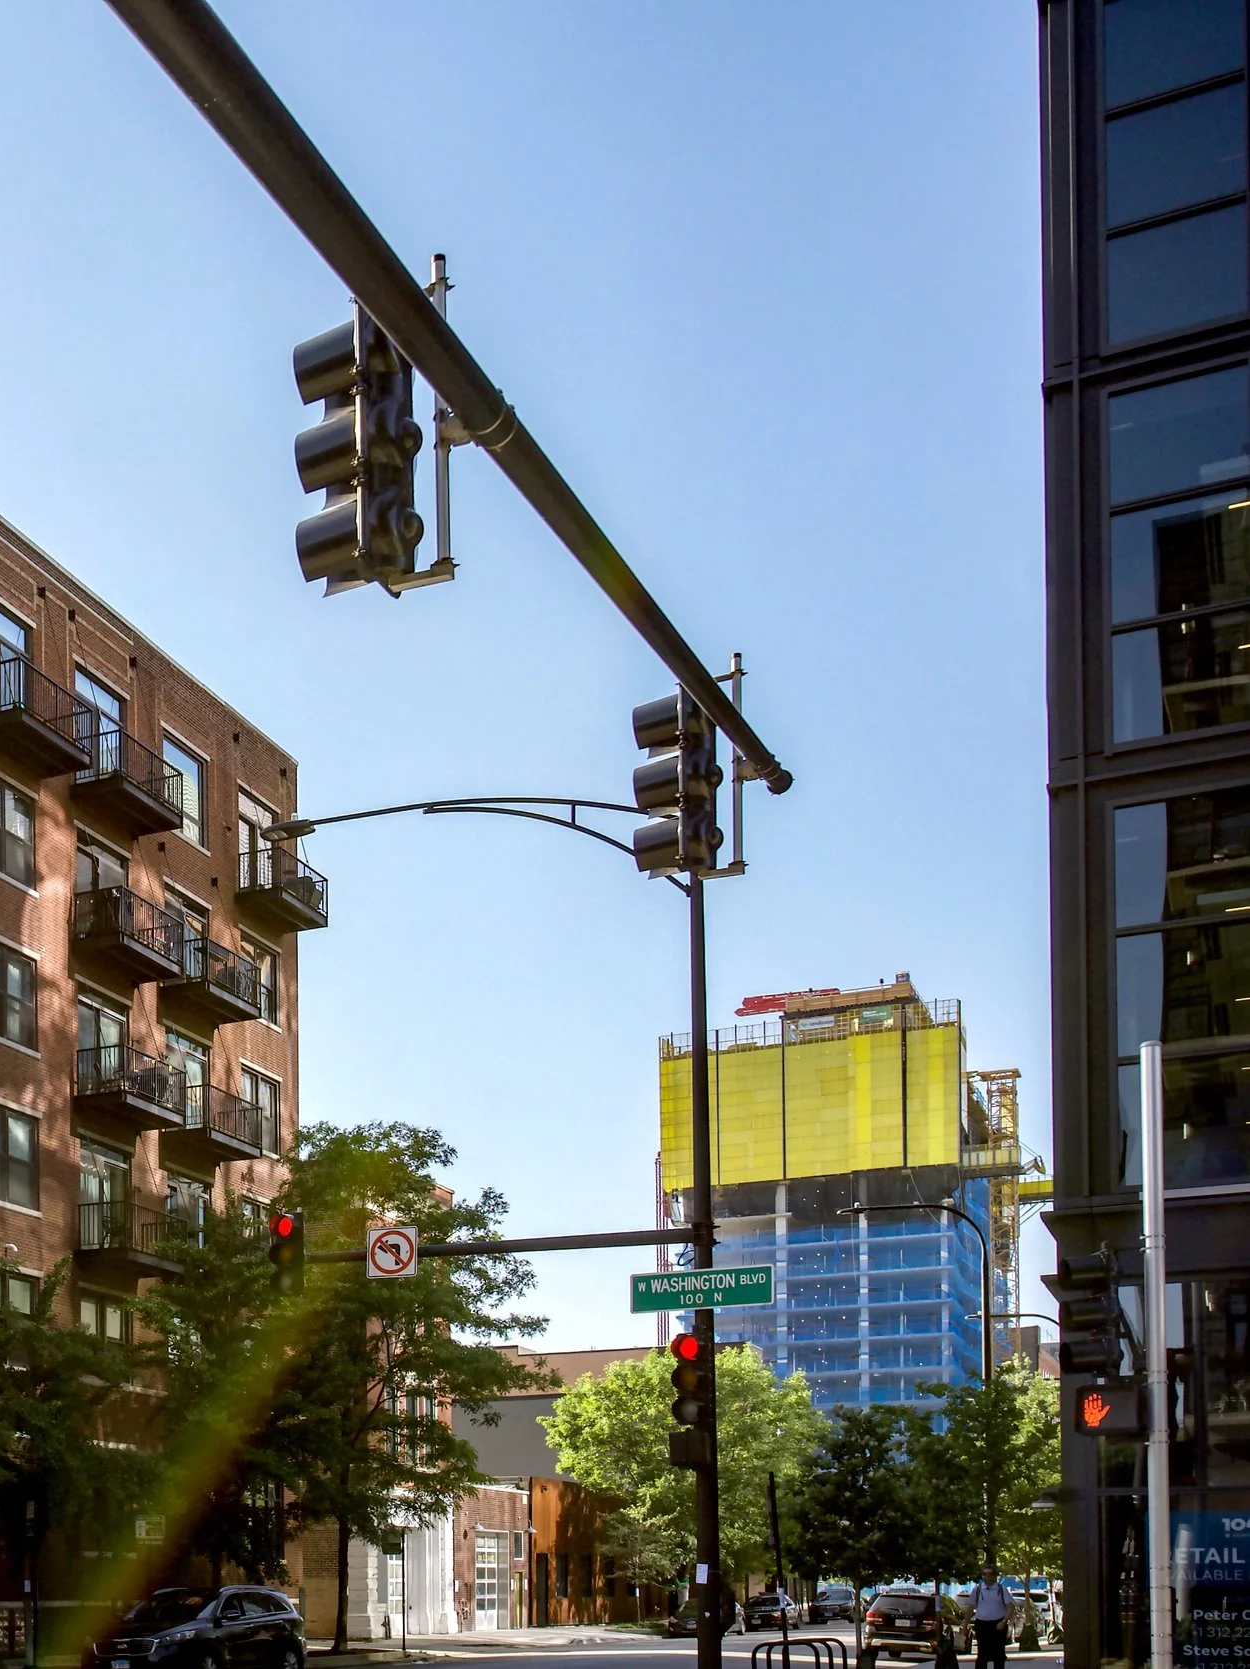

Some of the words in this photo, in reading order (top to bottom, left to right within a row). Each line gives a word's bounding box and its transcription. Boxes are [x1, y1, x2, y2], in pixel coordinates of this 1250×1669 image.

[638, 1282, 646, 1292] W
[651, 1273, 735, 1294] WASHINGTON
[739, 1273, 766, 1285] BLVD
[680, 1294, 703, 1305] 100
[714, 1292, 722, 1303] N
[1169, 1547, 1246, 1564] ETAIL
[1193, 1609, 1239, 1621] Peter
[1183, 1644, 1230, 1657] Steve
